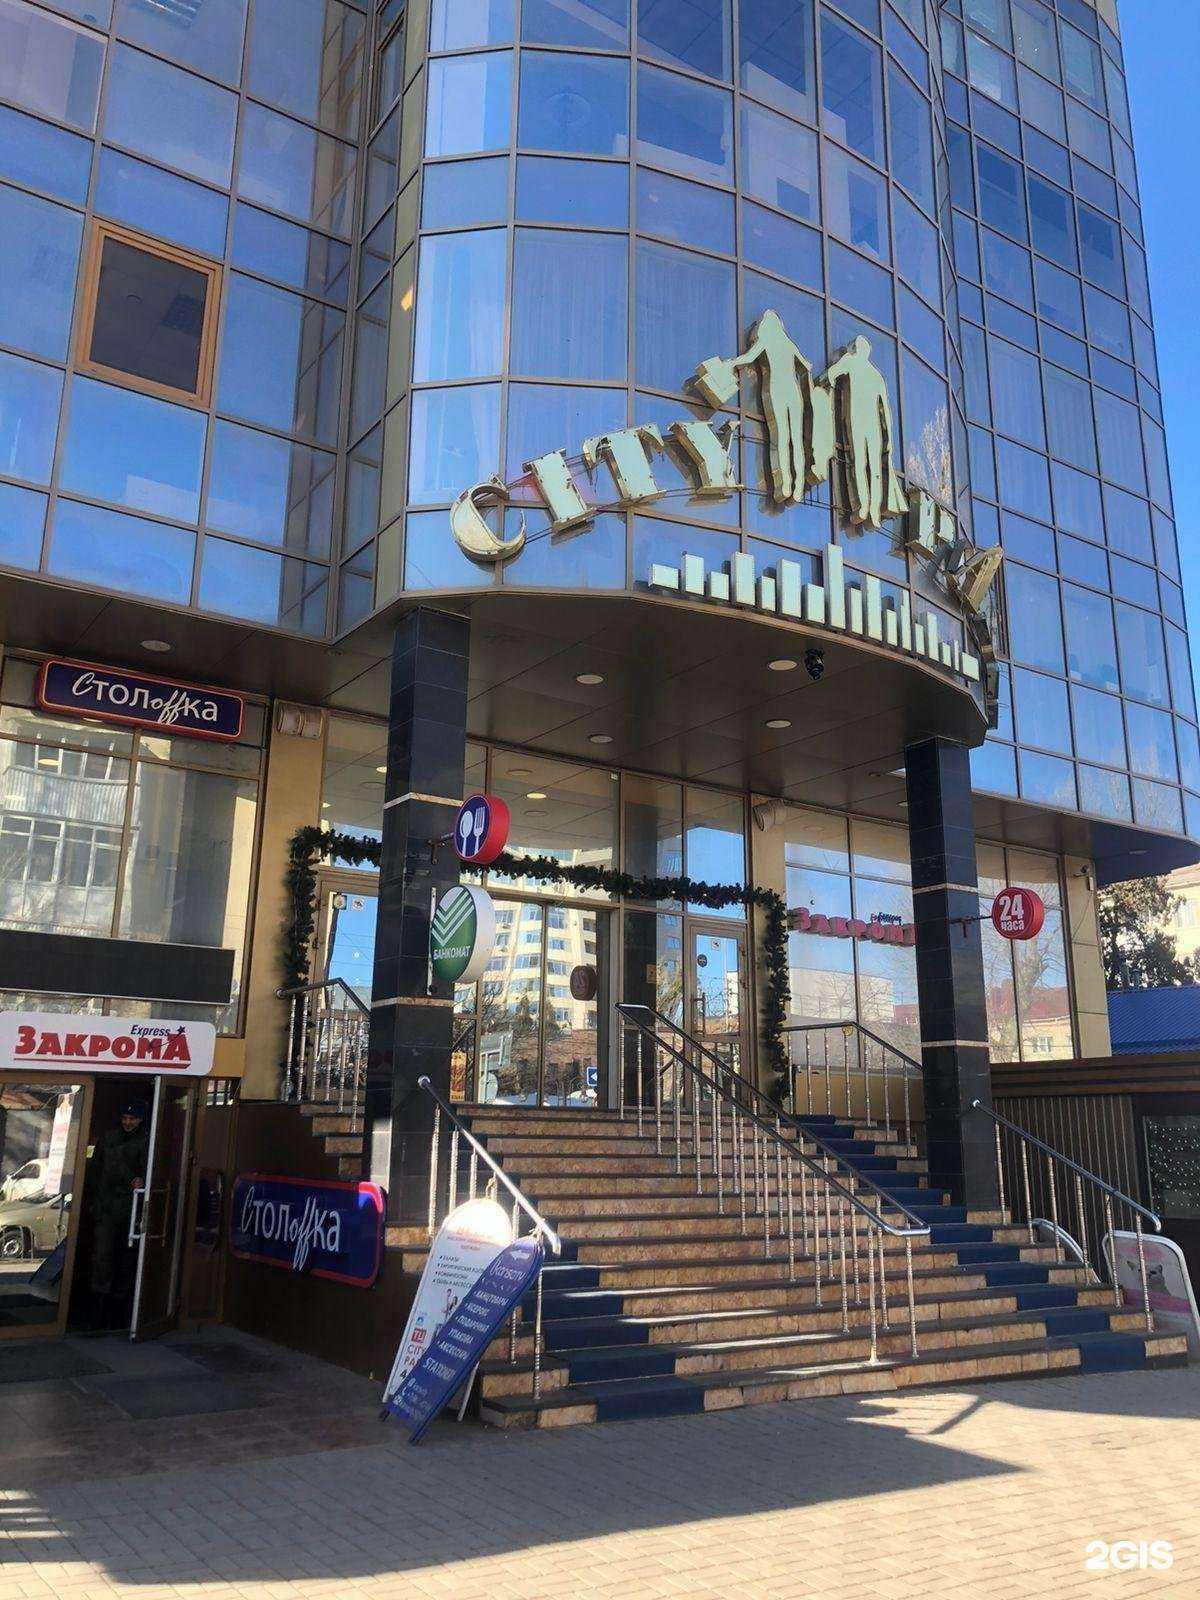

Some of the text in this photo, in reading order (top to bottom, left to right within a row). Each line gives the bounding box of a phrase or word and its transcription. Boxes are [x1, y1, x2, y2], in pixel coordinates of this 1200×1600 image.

[450, 420, 744, 563] CITY
[999, 894, 1024, 920] 24
[1000, 919, 1025, 931] часа
[432, 945, 471, 960] БАНКОМАТ
[130, 1024, 171, 1038] Express
